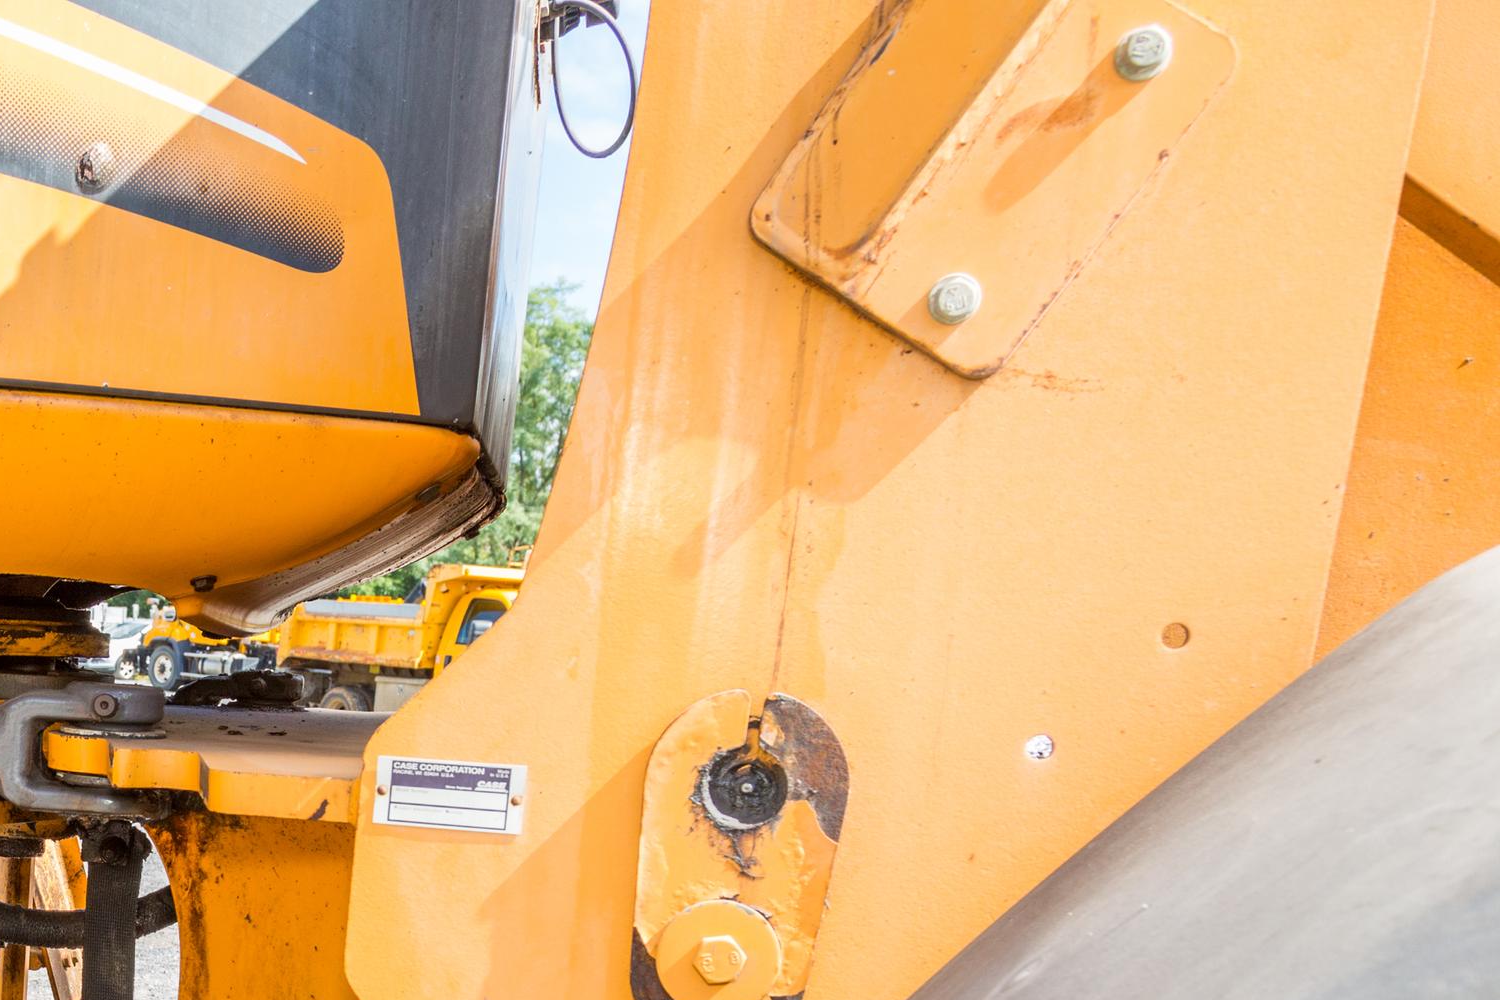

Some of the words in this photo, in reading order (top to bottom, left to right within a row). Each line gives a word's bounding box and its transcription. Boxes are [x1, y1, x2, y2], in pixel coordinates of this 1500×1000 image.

[393, 762, 419, 770] CASE
[419, 763, 485, 775] CORPORATION
[476, 780, 507, 790] CASE
